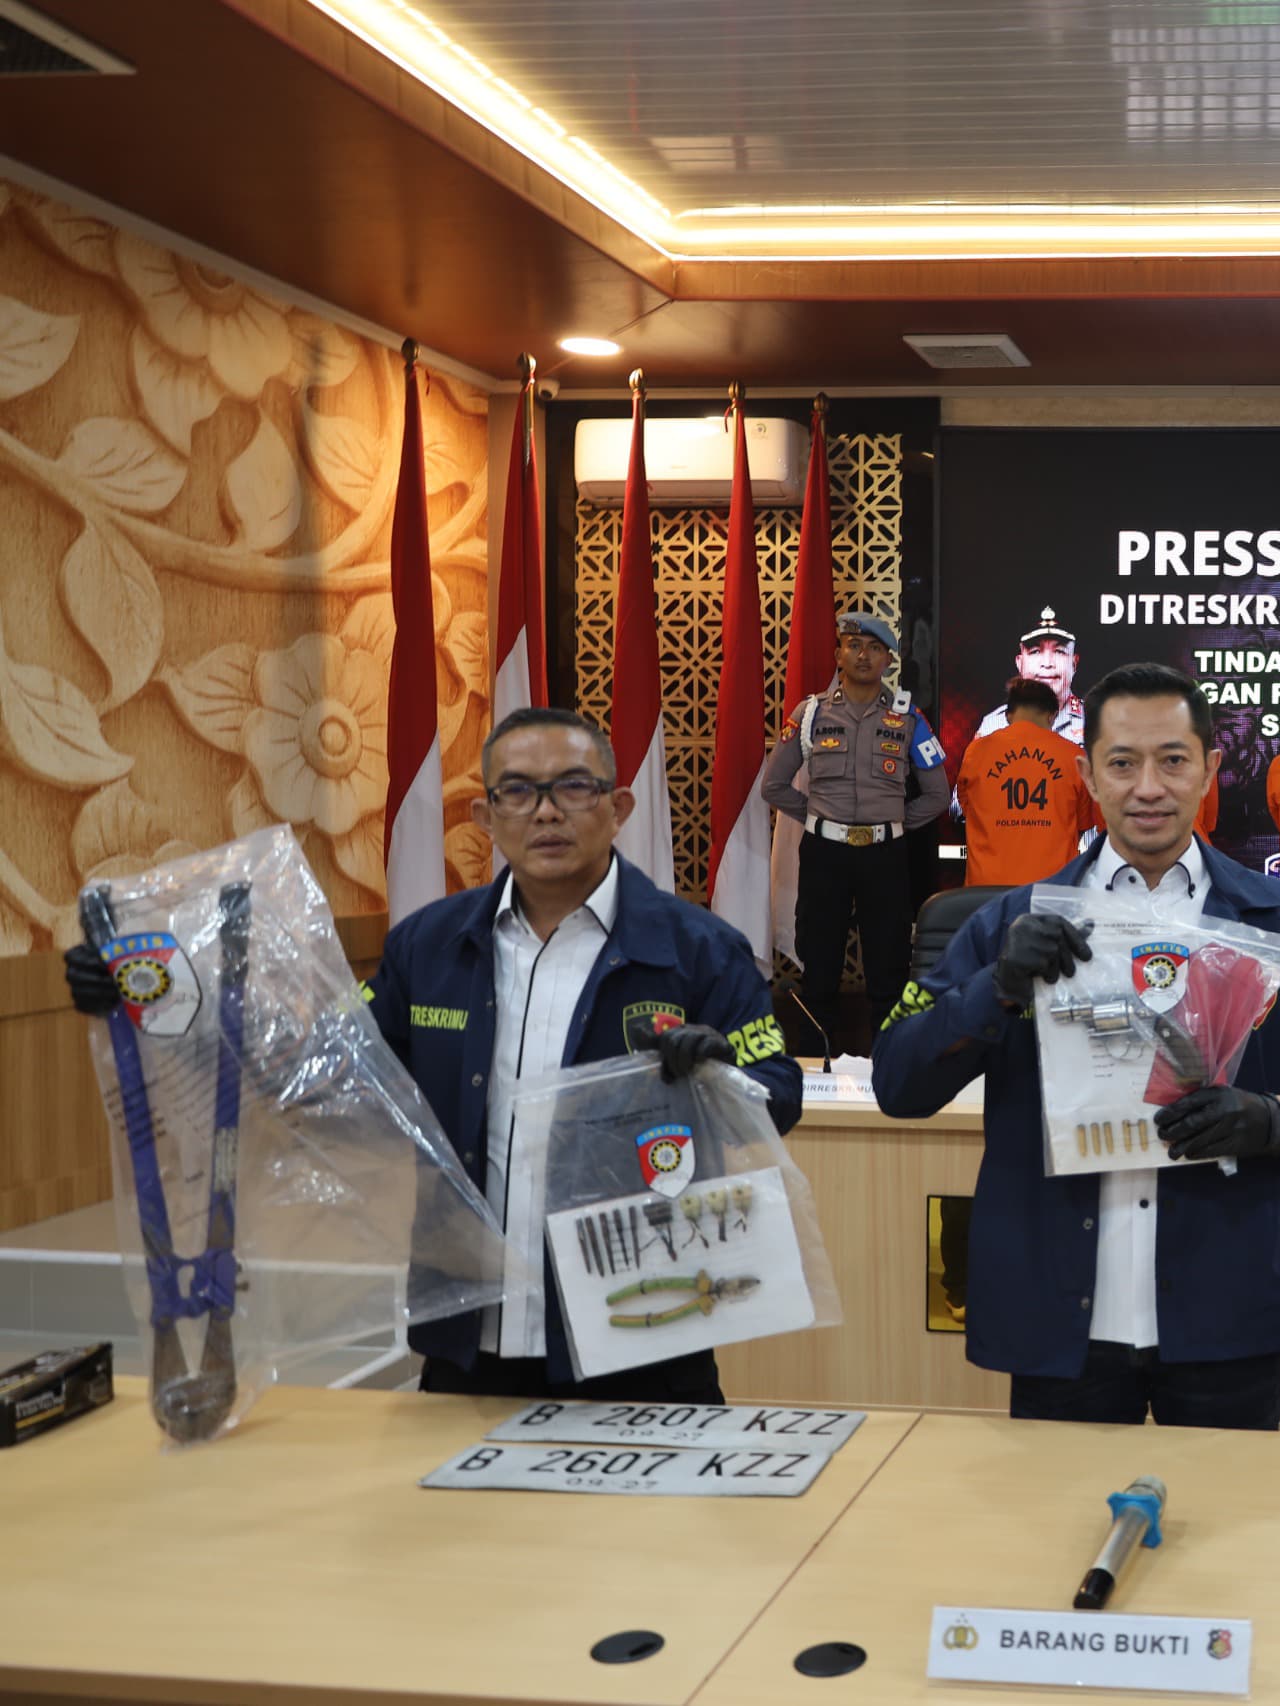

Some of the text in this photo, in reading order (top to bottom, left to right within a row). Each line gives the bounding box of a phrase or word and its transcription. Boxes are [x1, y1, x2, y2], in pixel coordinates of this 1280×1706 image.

[987, 747, 1064, 782] TAHANAN
[1001, 778, 1048, 811] 104
[995, 819, 1052, 827] POLDA BANTEN
[520, 1403, 848, 1436] B 2607 KZZ
[457, 1446, 811, 1478] B 2607 KZZ
[1000, 1629, 1190, 1656] BARANG BUKTI
